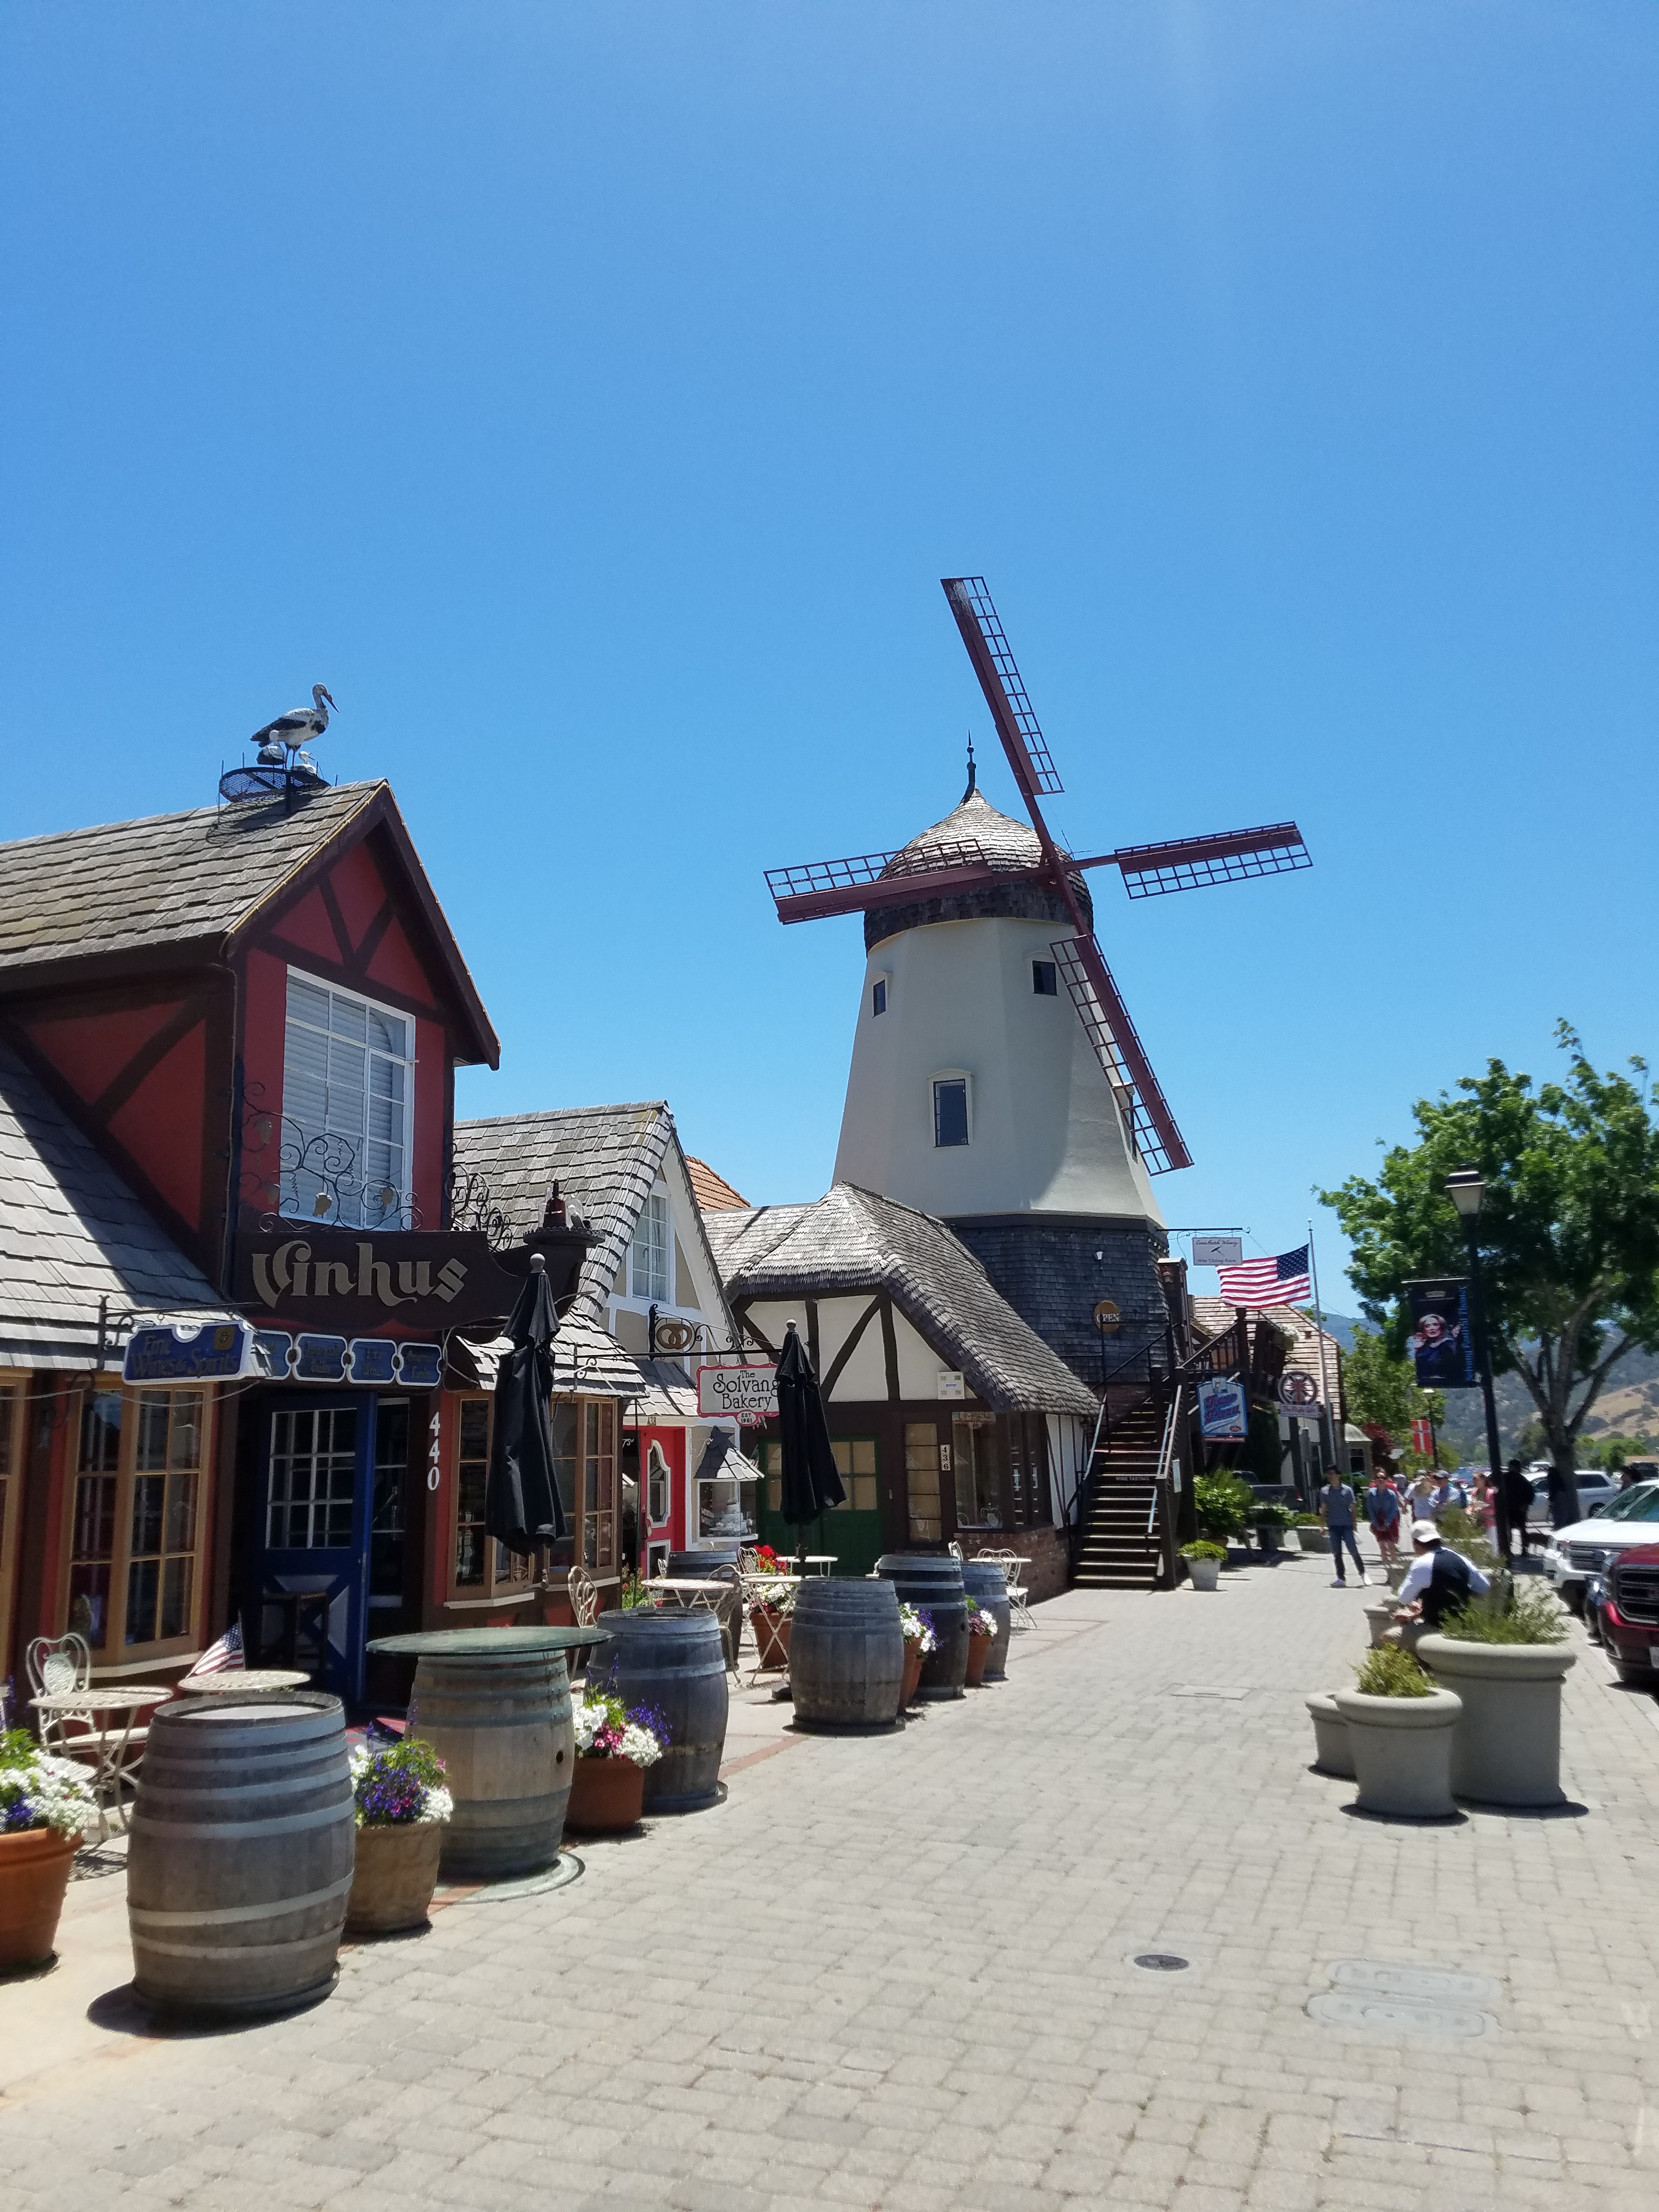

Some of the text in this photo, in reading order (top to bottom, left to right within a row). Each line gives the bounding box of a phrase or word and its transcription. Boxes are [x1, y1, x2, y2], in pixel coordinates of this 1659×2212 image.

[252, 1240, 469, 1308] Vinhus
[713, 1373, 780, 1397] Solvang
[722, 1393, 772, 1411] Bakery
[427, 1411, 441, 1491] 440
